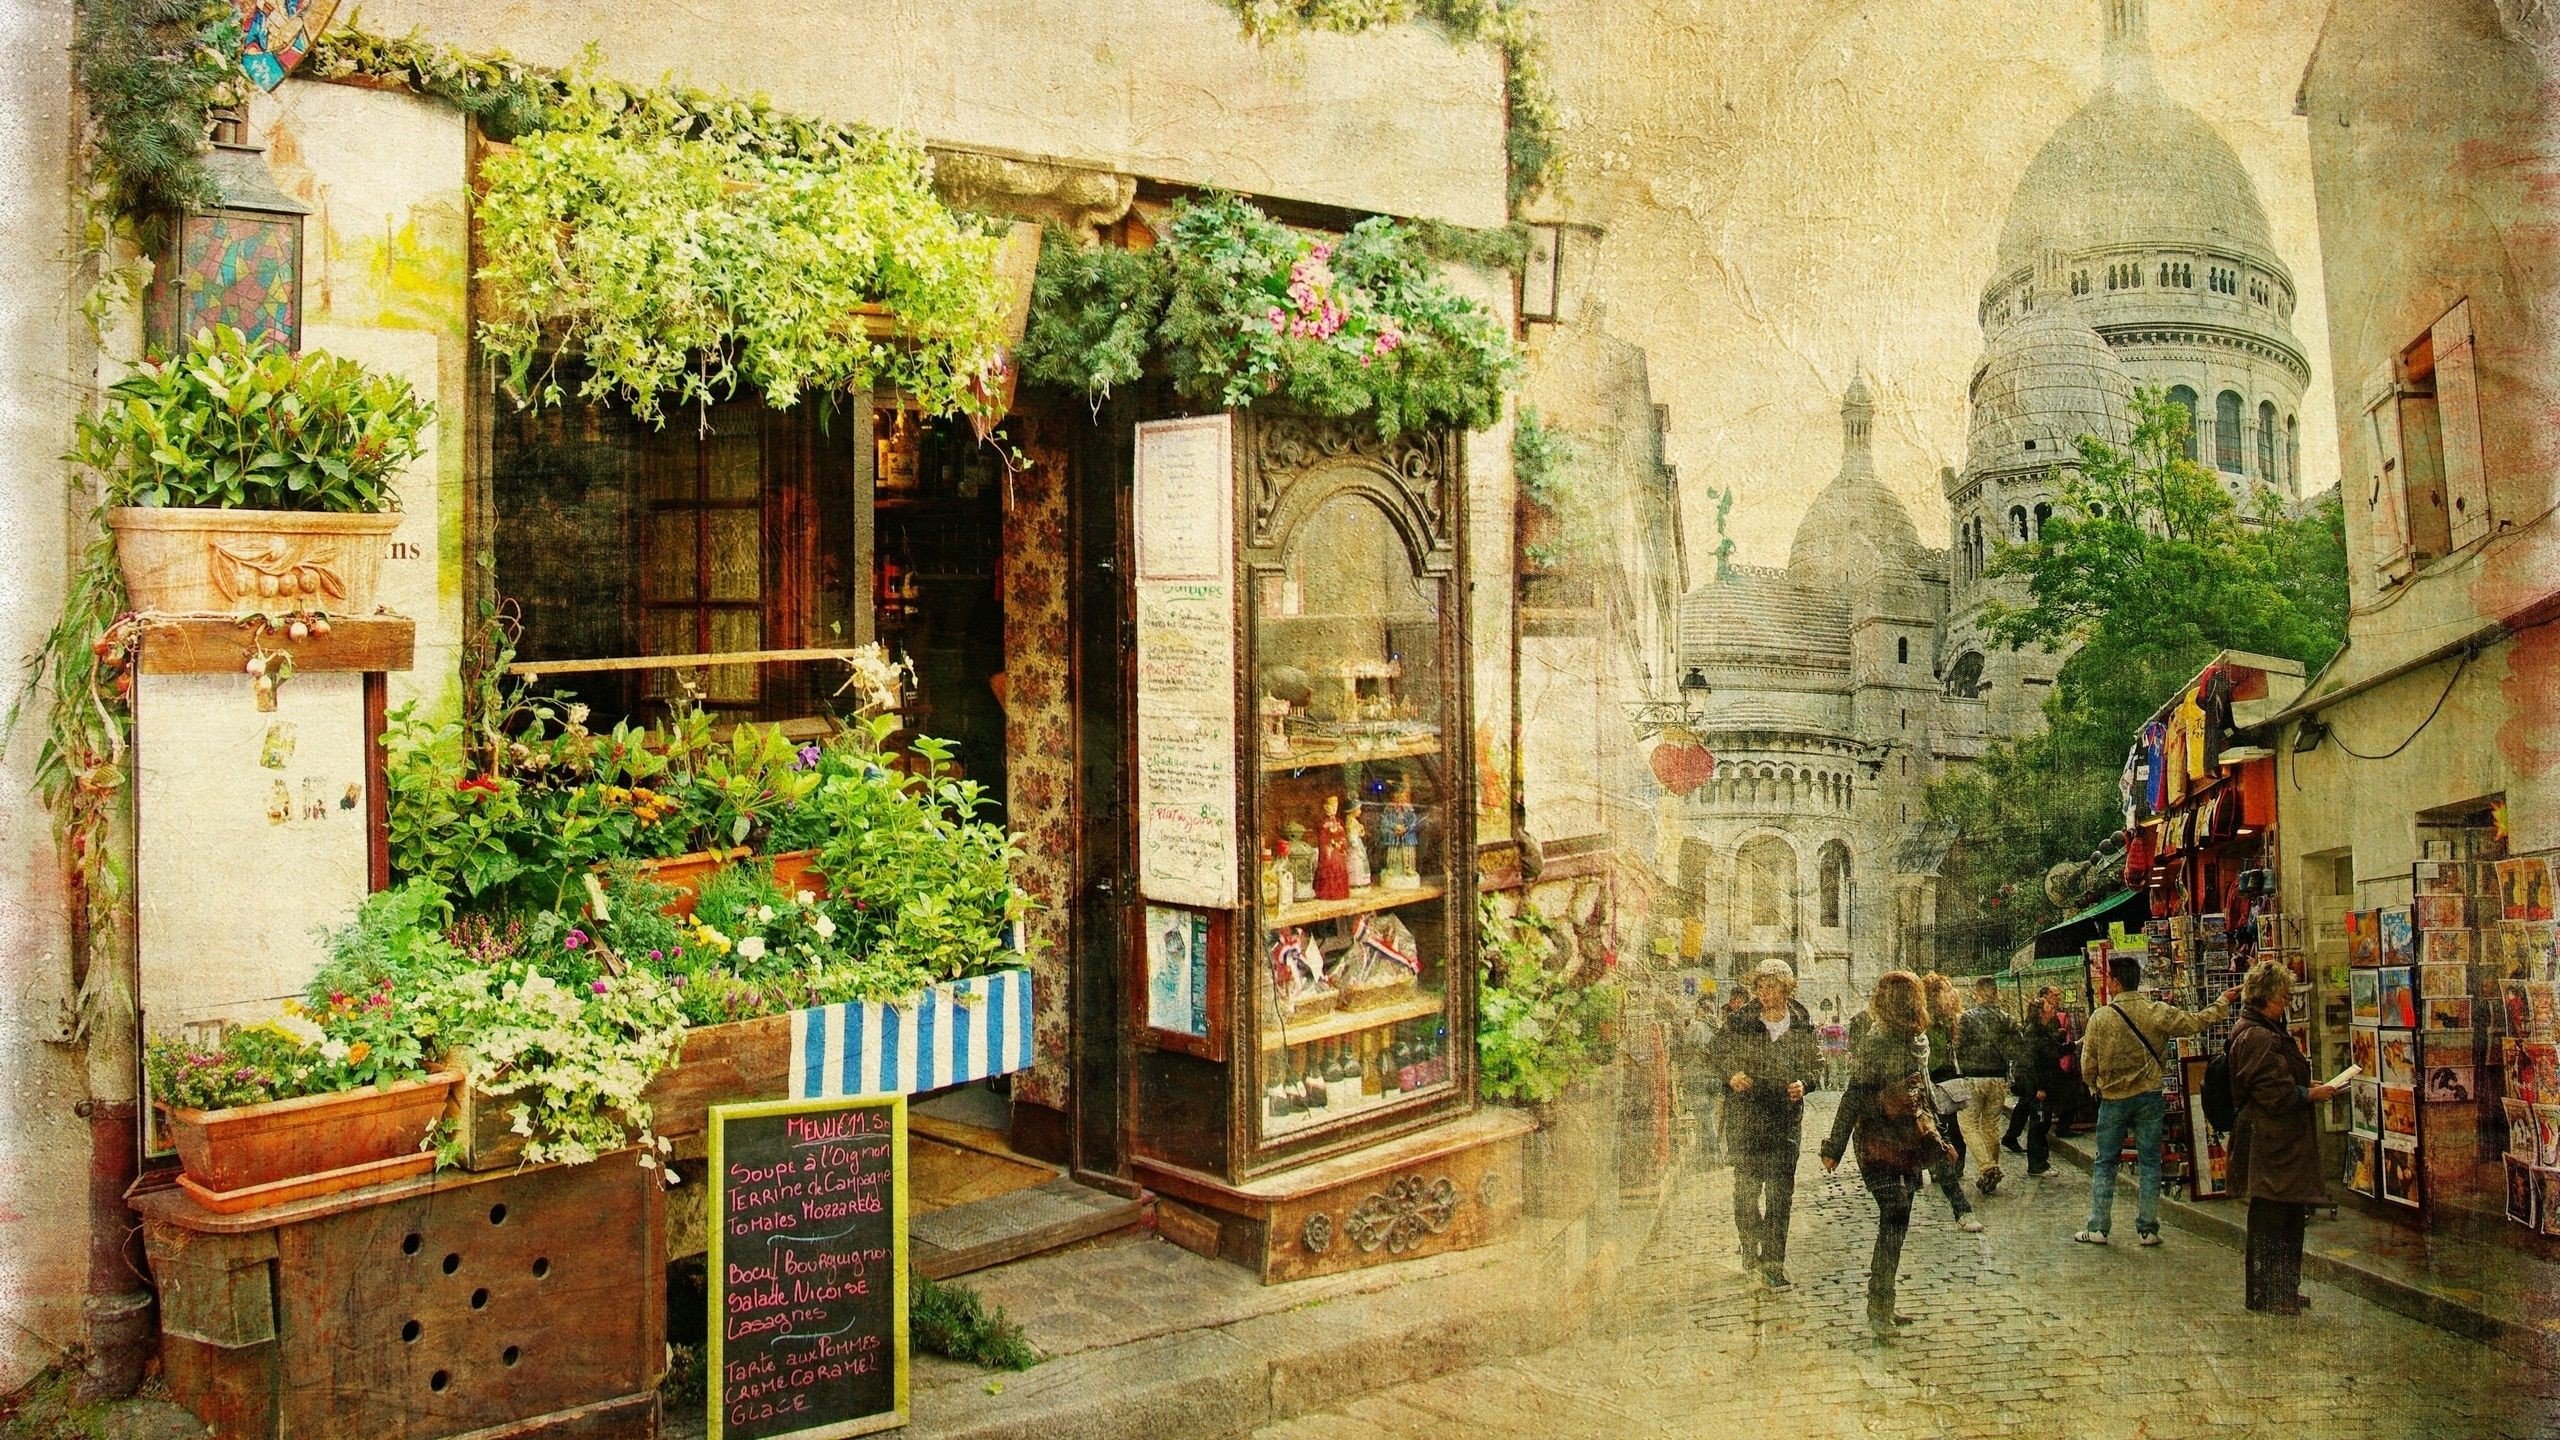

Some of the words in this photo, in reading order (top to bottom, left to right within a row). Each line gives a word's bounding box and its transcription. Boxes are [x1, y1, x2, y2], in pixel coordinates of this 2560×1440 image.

[384, 543, 420, 560] ns
[787, 1116, 836, 1142] MENU
[803, 1152, 817, 1172] à
